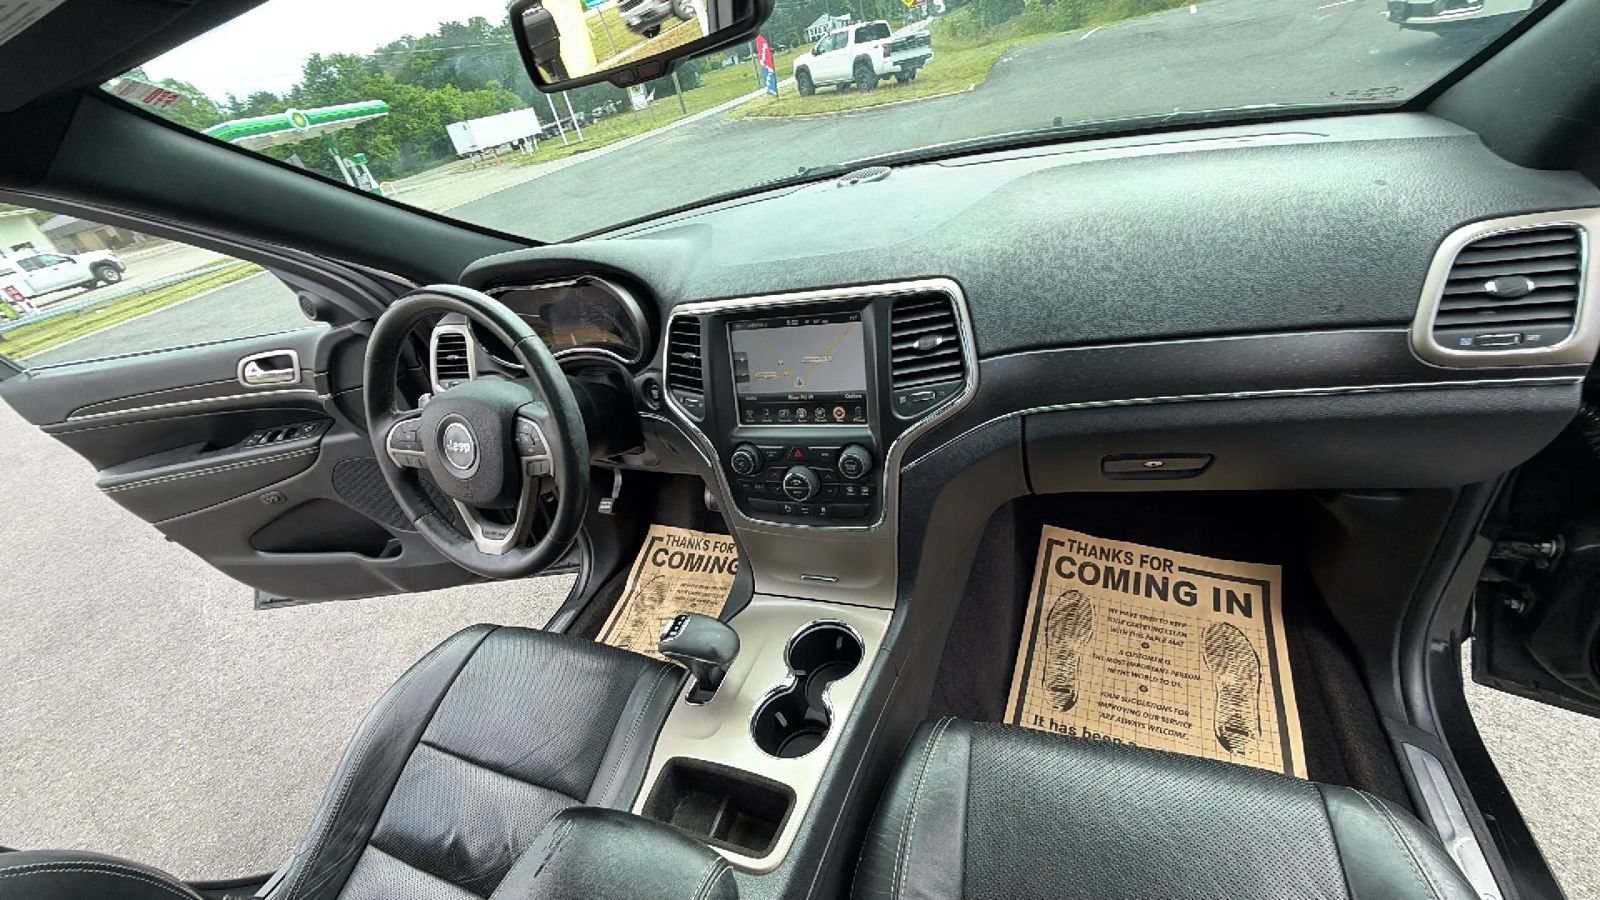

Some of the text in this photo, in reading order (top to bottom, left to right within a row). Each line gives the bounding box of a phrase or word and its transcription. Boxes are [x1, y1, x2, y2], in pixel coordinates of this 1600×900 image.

[446, 439, 470, 454] Jeep
[666, 534, 735, 554] THANKS FOR
[652, 548, 738, 576] COMING
[1066, 538, 1174, 573] THANKS FOR
[1055, 556, 1252, 618] COMING IN
[1110, 626, 1128, 635] WITH
[1129, 631, 1144, 639] THIS
[1145, 634, 1167, 644] PAPER
[1126, 621, 1163, 633] CARPETING
[1164, 628, 1187, 638] CLEAN
[1106, 657, 1126, 666] MOST
[1127, 661, 1169, 674] IMPORTANT
[1170, 671, 1200, 680] PERSON
[1125, 651, 1164, 664] CUSTOMER
[1131, 672, 1158, 682] WORLD
[1098, 701, 1192, 728] IMPROVING OUR SERVICE
[1100, 691, 1189, 717] YOUR SUGGESTIONS FOR
[1033, 714, 1045, 727] It
[1050, 718, 1077, 736] has
[1115, 716, 1146, 729] ALWAYS
[1148, 724, 1189, 740] WELCOME.
